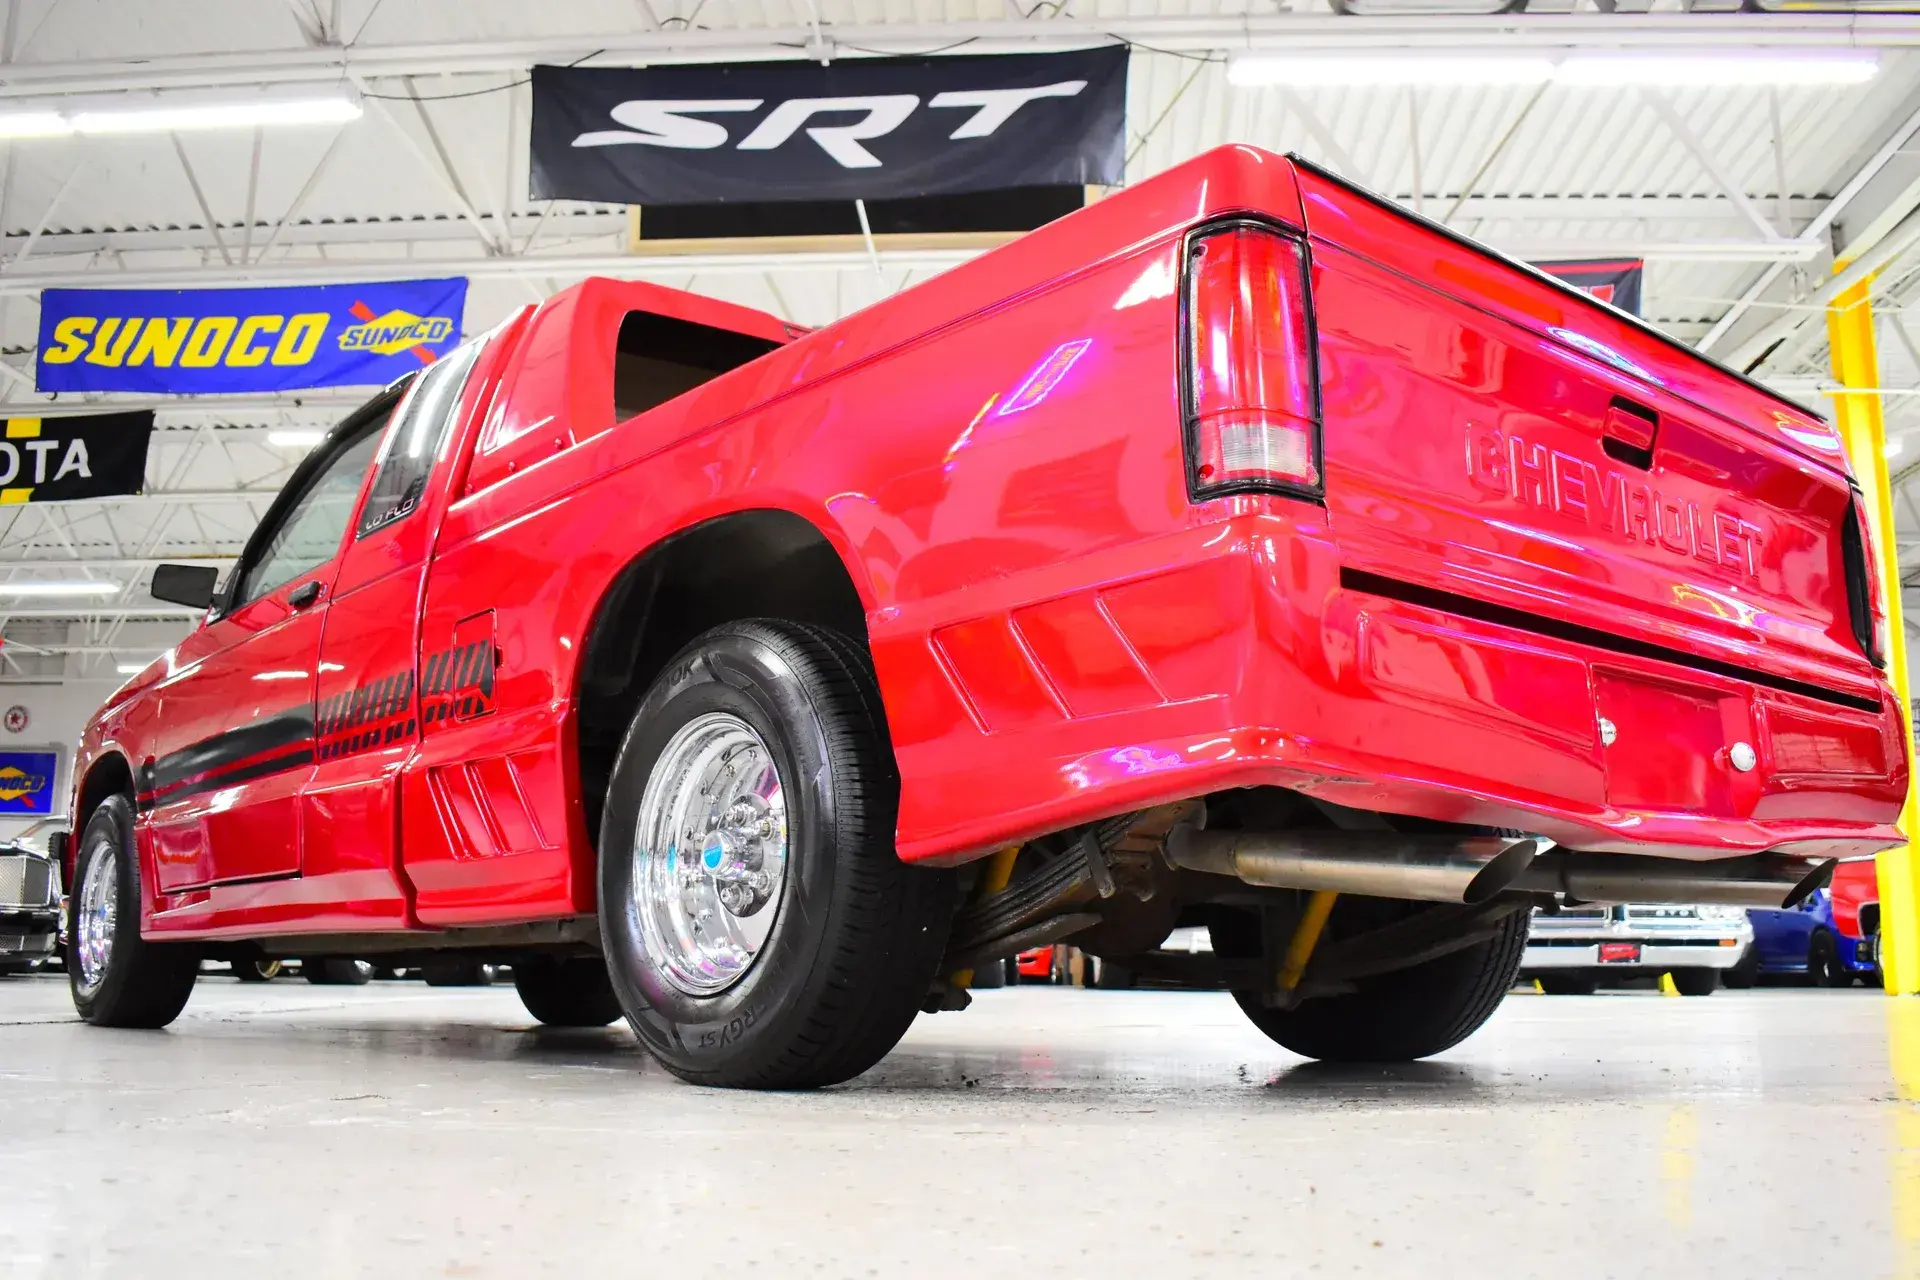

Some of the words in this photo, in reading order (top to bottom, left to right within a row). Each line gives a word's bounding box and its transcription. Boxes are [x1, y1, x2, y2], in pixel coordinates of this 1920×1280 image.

[571, 79, 1089, 169] SRT
[43, 312, 331, 367] SUNOCO
[343, 320, 449, 347] SUNOCO
[385, 498, 415, 520] FLO
[1464, 421, 1763, 581] CHEVROLET
